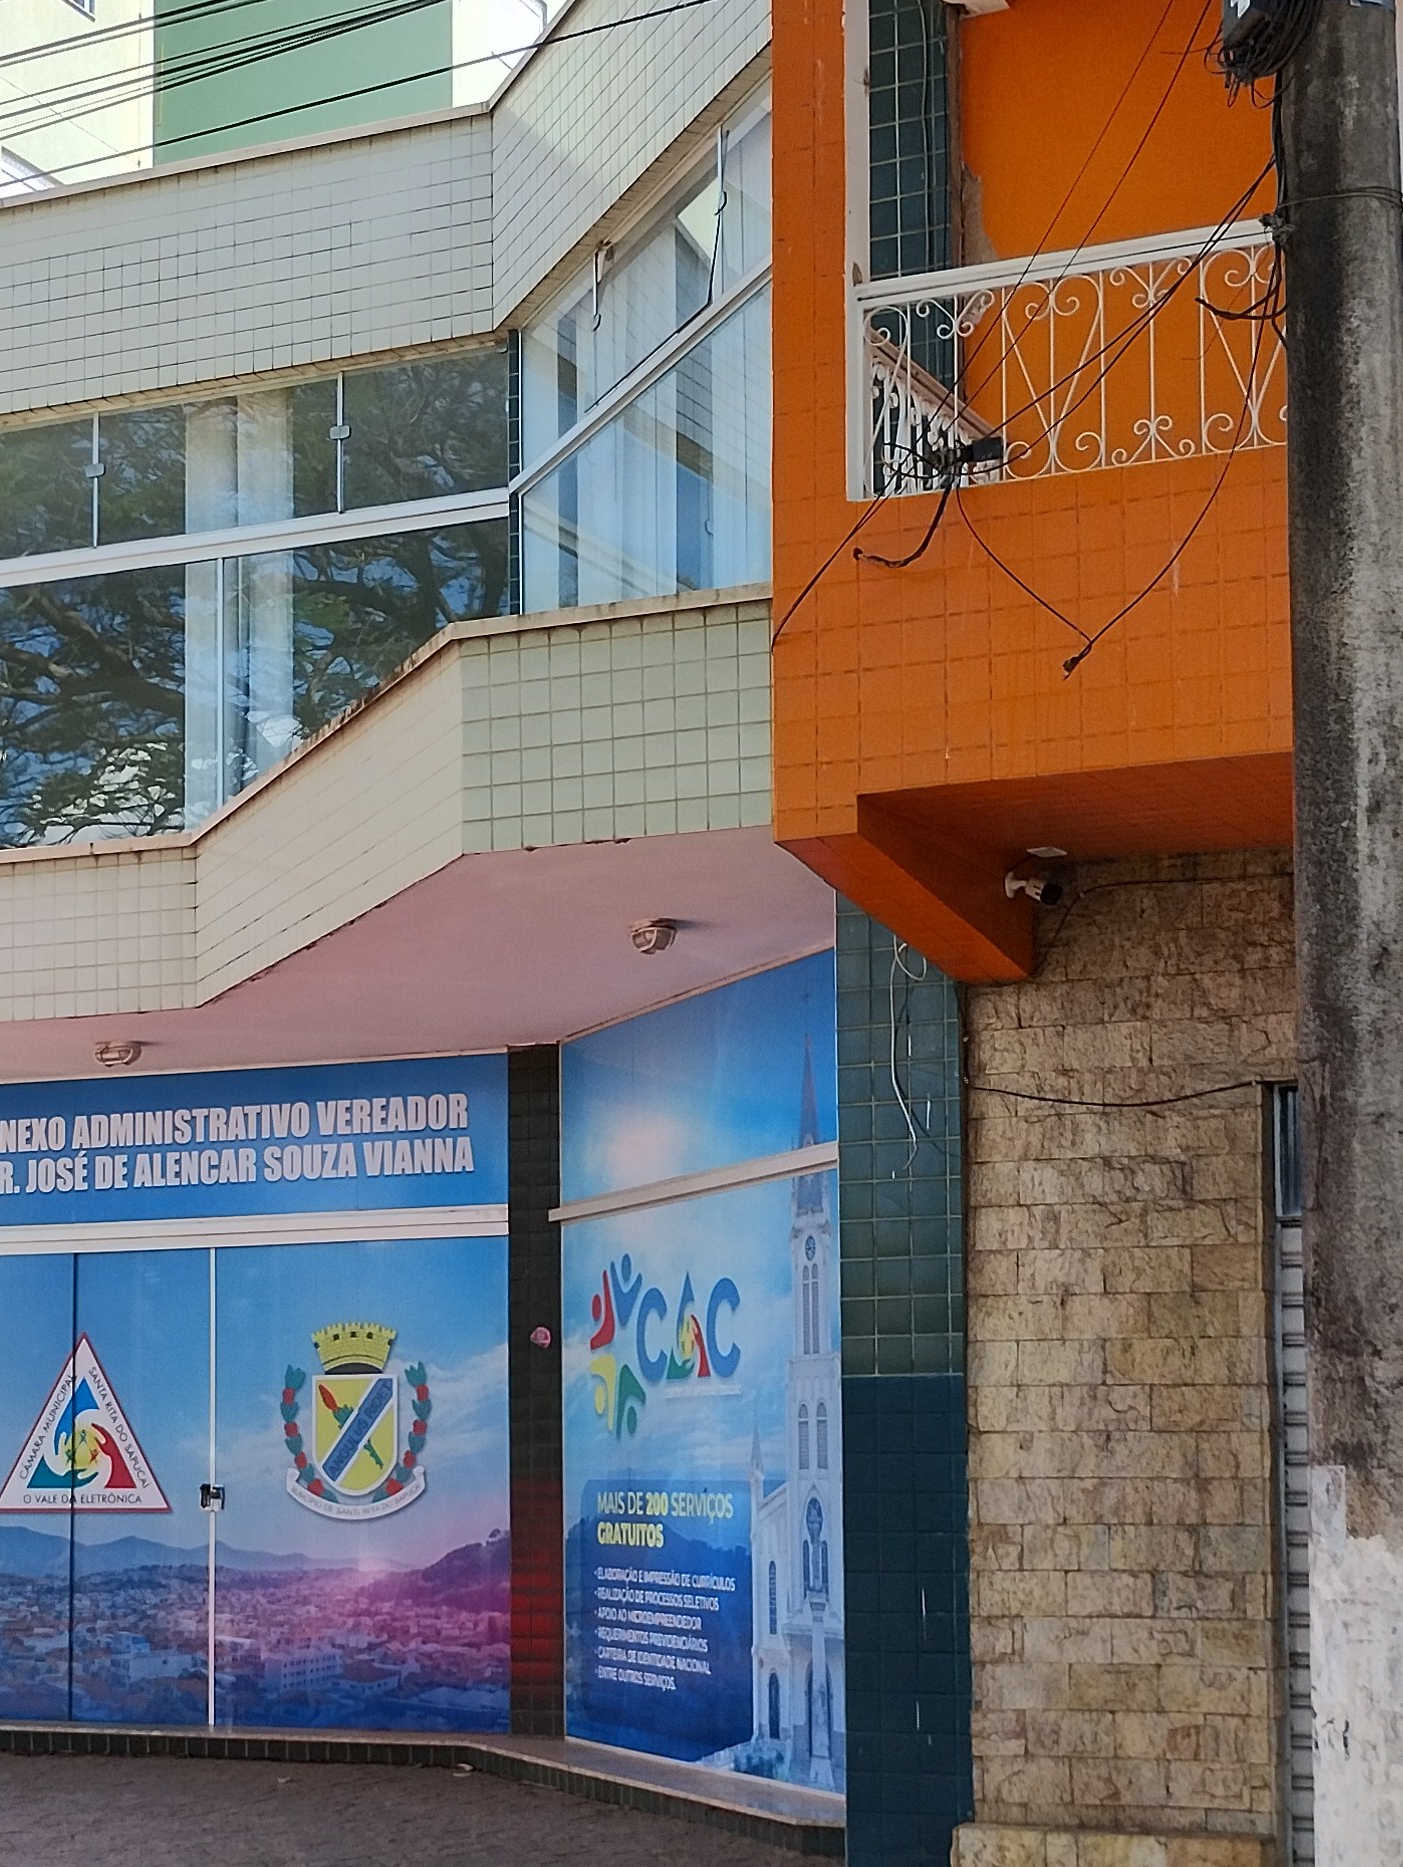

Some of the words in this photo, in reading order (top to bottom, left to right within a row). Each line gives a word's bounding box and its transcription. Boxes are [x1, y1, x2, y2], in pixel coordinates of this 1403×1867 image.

[72, 1102, 310, 1149] ADMINISTRATIVO
[317, 1093, 468, 1136] VEREADOR
[26, 1151, 88, 1193] JOSÉ
[95, 1154, 128, 1190] DE
[133, 1147, 256, 1188] ALENCAR
[264, 1142, 357, 1182] SOUZA
[363, 1136, 474, 1177] VIANNA
[88, 1366, 108, 1401] SANTA
[105, 1401, 119, 1424] RITA
[115, 1424, 128, 1442] DO
[19, 1435, 46, 1480] CÂMARA
[43, 1374, 78, 1433] MUNICIPAL
[23, 1494, 32, 1504] O
[35, 1494, 57, 1504] VALE
[61, 1494, 76, 1504] DA
[80, 1492, 142, 1504] ELETRÔNICA
[598, 1491, 625, 1515] MAIS
[627, 1491, 644, 1515] DE
[646, 1491, 669, 1517] 200
[670, 1492, 734, 1526] SERVIÇOS
[597, 1521, 664, 1549] GRATUITOS
[681, 1573, 691, 1587] DE
